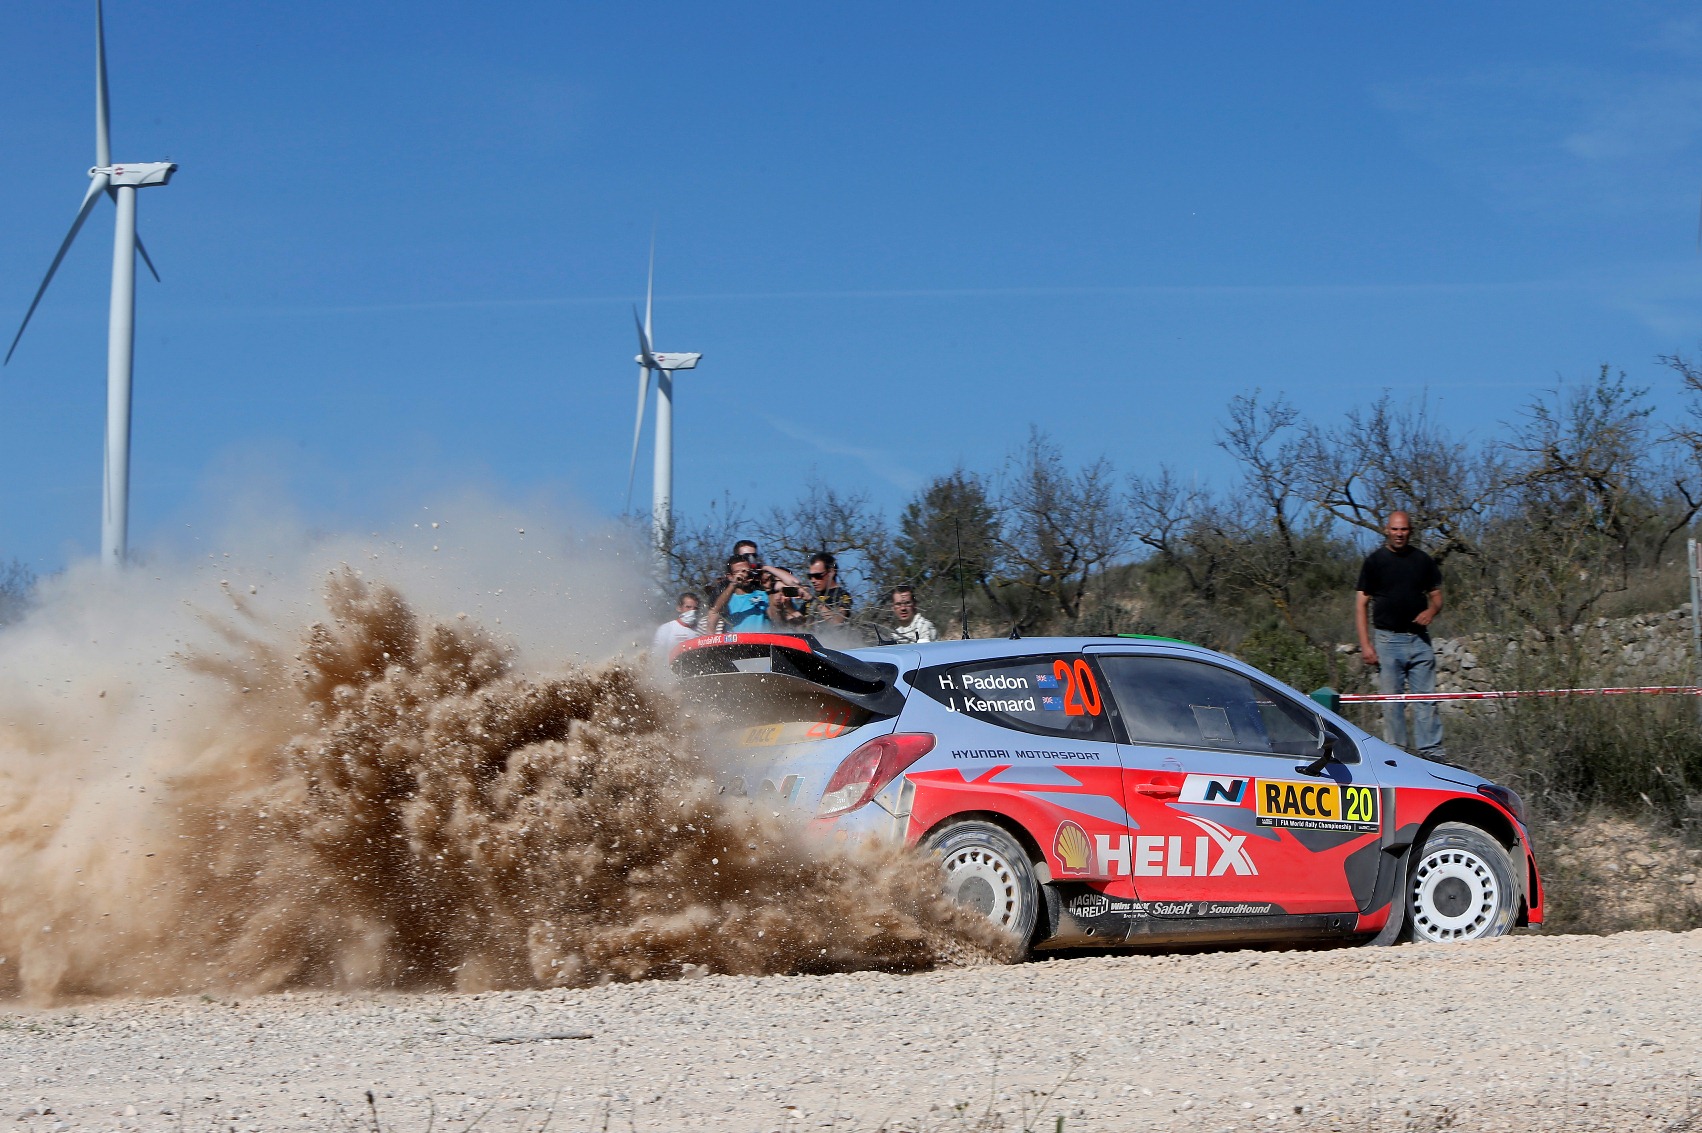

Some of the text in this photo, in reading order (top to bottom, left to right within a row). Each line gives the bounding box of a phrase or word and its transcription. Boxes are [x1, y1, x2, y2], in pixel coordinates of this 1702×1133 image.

[938, 674, 1028, 690] H. Paddon
[1053, 659, 1101, 716] 20
[945, 696, 1036, 712] J. Kennard
[952, 749, 1100, 761] HYUNDAI MOTORSPORT
[1203, 779, 1247, 802] N
[1265, 783, 1332, 816] RACC
[1346, 787, 1373, 821] 20
[1305, 821, 1317, 829] Rally
[1318, 821, 1352, 831] Championship
[1094, 816, 1259, 876] HELIX
[1152, 901, 1193, 915] Sabelt
[1208, 903, 1272, 914] SoundHound
